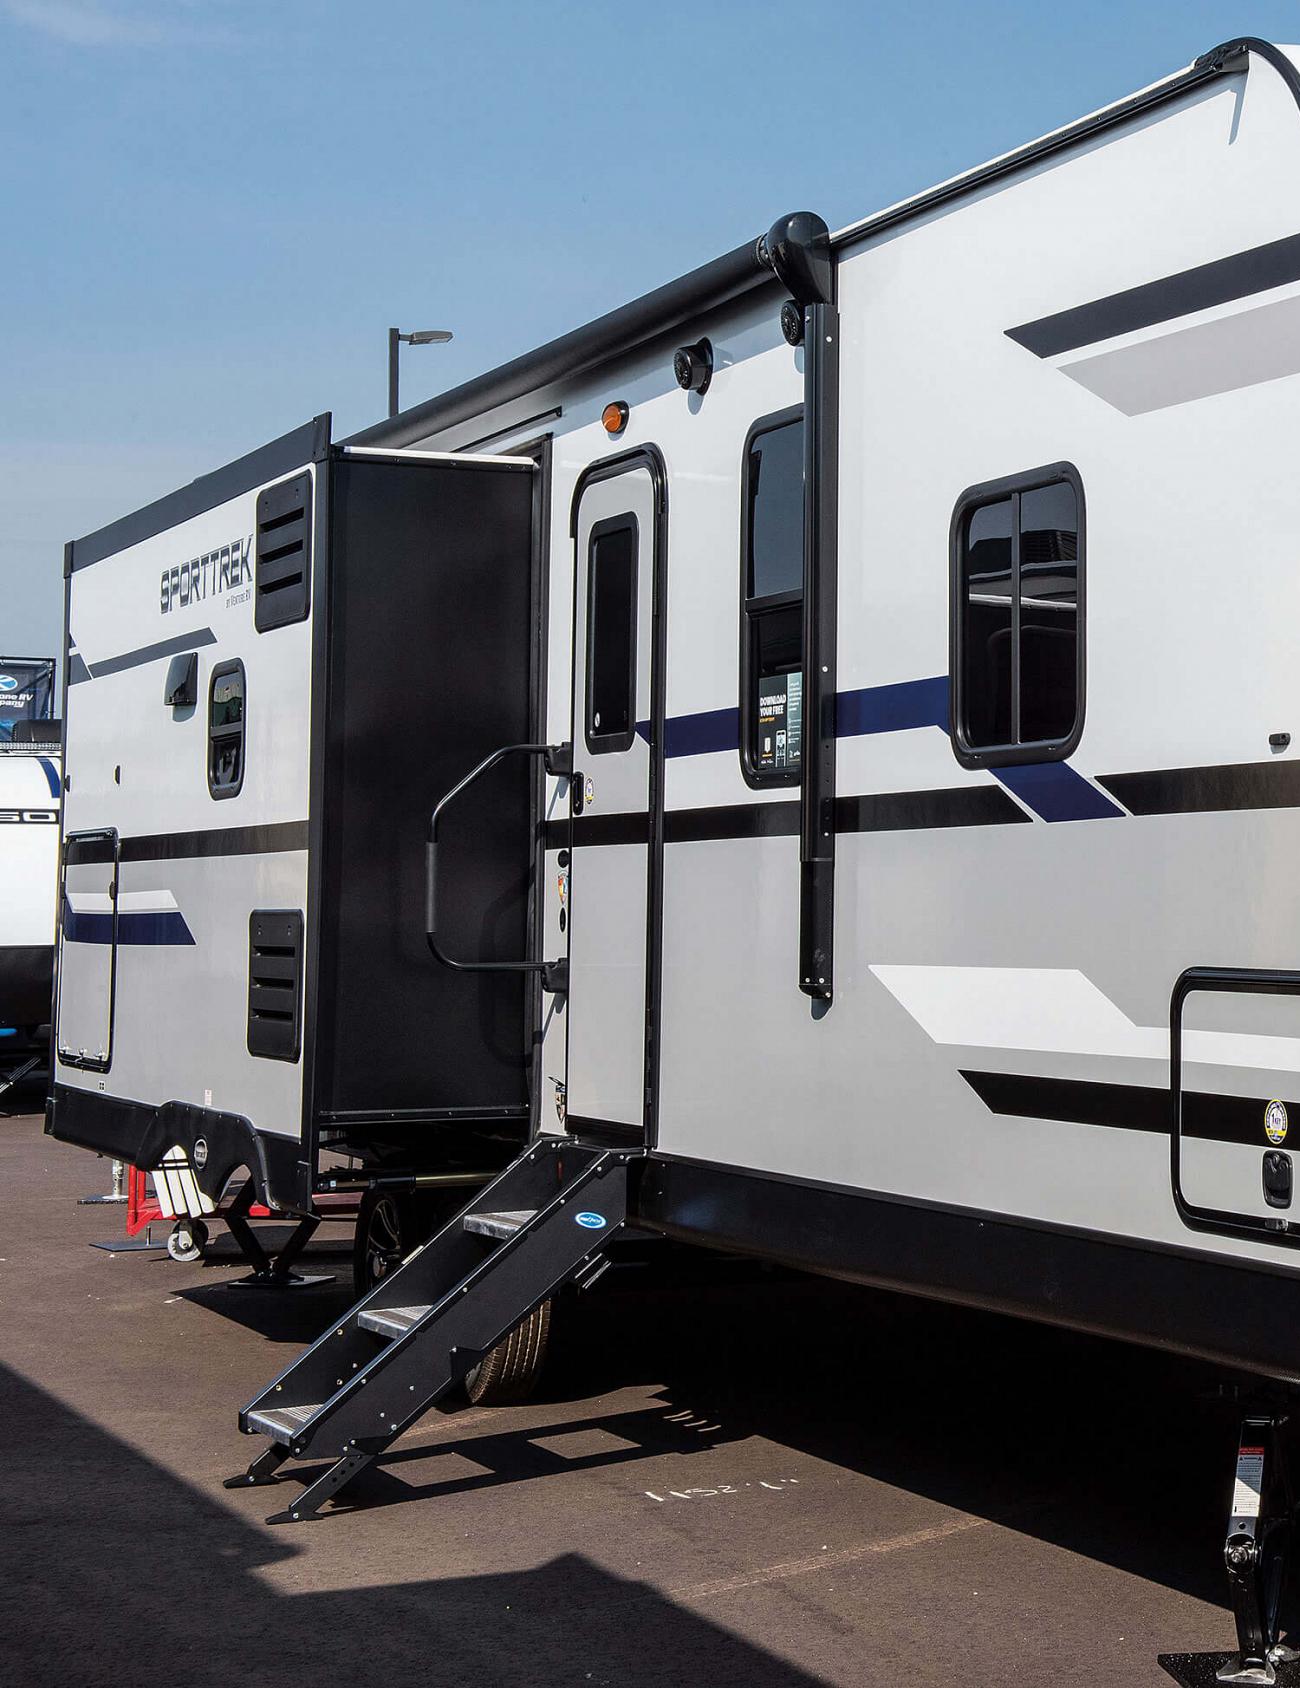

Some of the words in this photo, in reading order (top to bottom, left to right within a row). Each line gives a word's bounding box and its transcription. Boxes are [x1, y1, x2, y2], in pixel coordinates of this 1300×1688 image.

[161, 533, 254, 615] SPORTTREK
[760, 694, 786, 706] DOWNLOAD
[760, 707, 772, 716] YOUR
[773, 705, 783, 715] FREE
